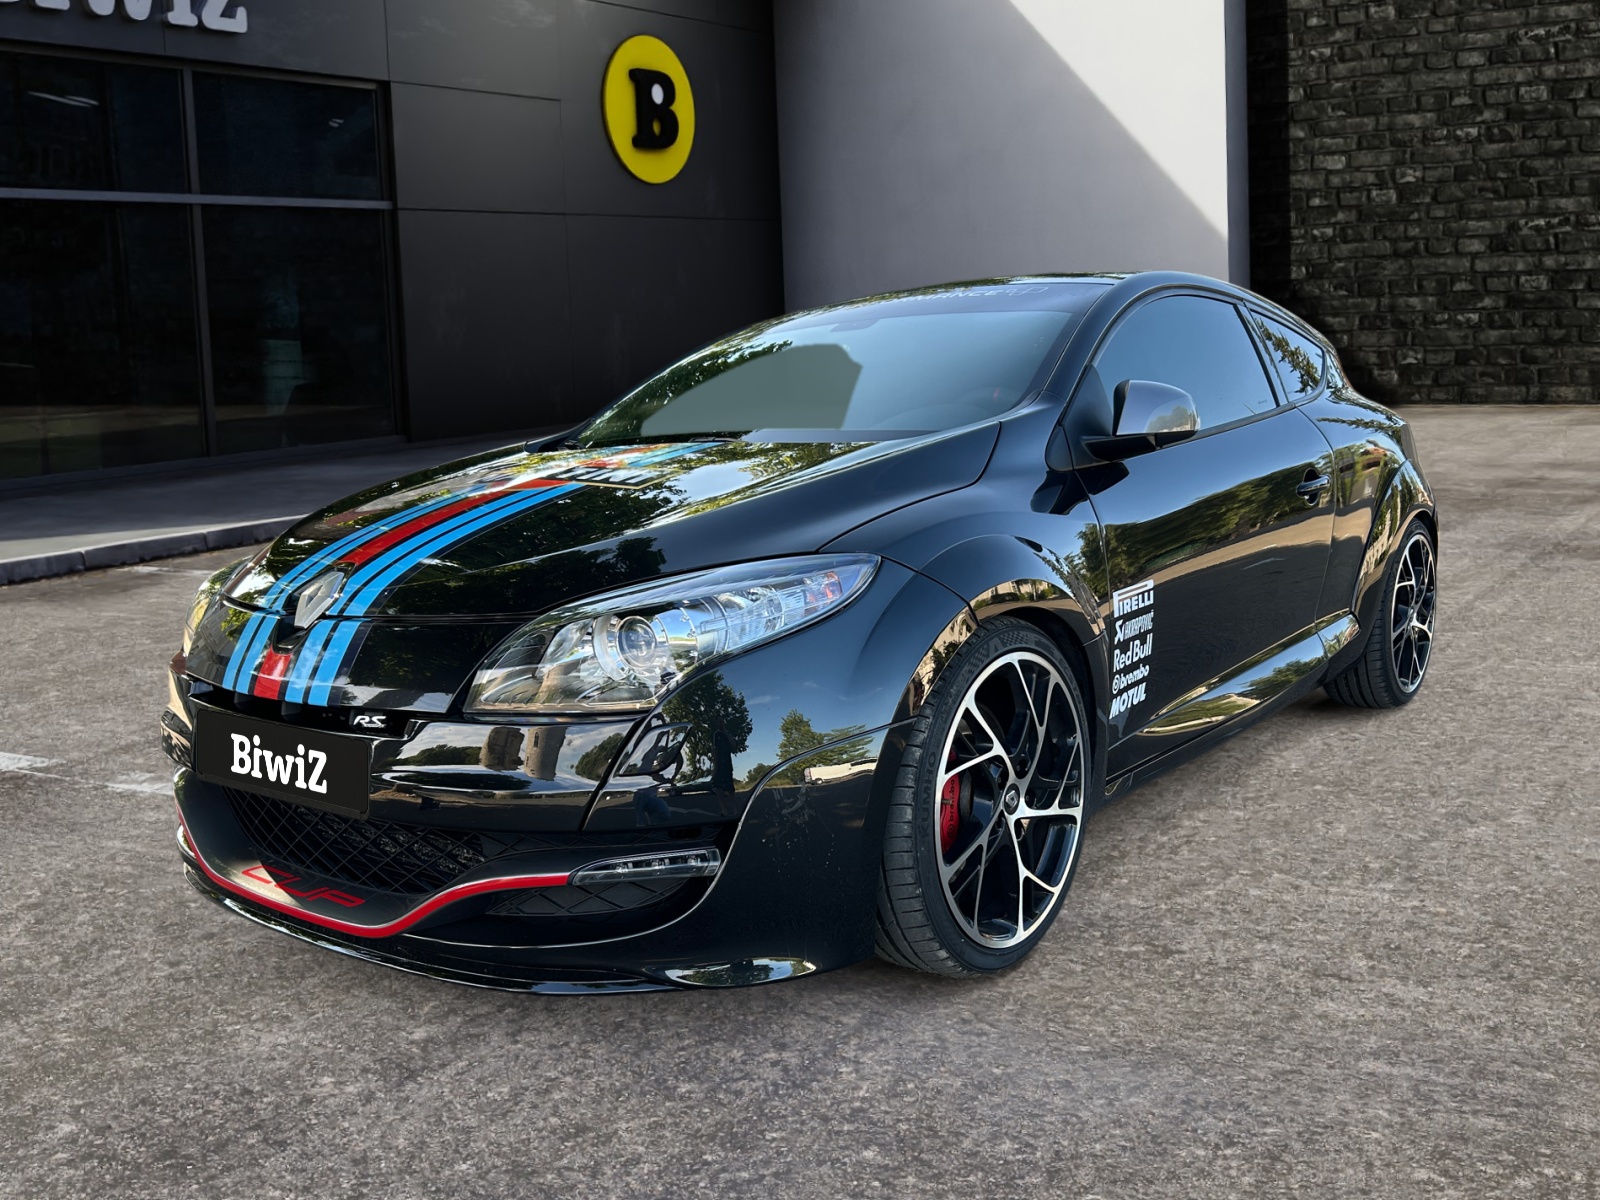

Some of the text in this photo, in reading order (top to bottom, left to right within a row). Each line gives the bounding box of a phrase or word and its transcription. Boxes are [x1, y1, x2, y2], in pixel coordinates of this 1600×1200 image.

[628, 67, 680, 150] B
[1113, 579, 1154, 618] PIRELLI
[1113, 633, 1153, 672] Red Bull
[1119, 664, 1149, 690] brembo
[1109, 682, 1146, 719] MOTUL
[353, 715, 387, 728] RS
[231, 733, 327, 794] BiwiZ
[918, 751, 937, 838] KUMHO
[241, 865, 366, 907] CUP
